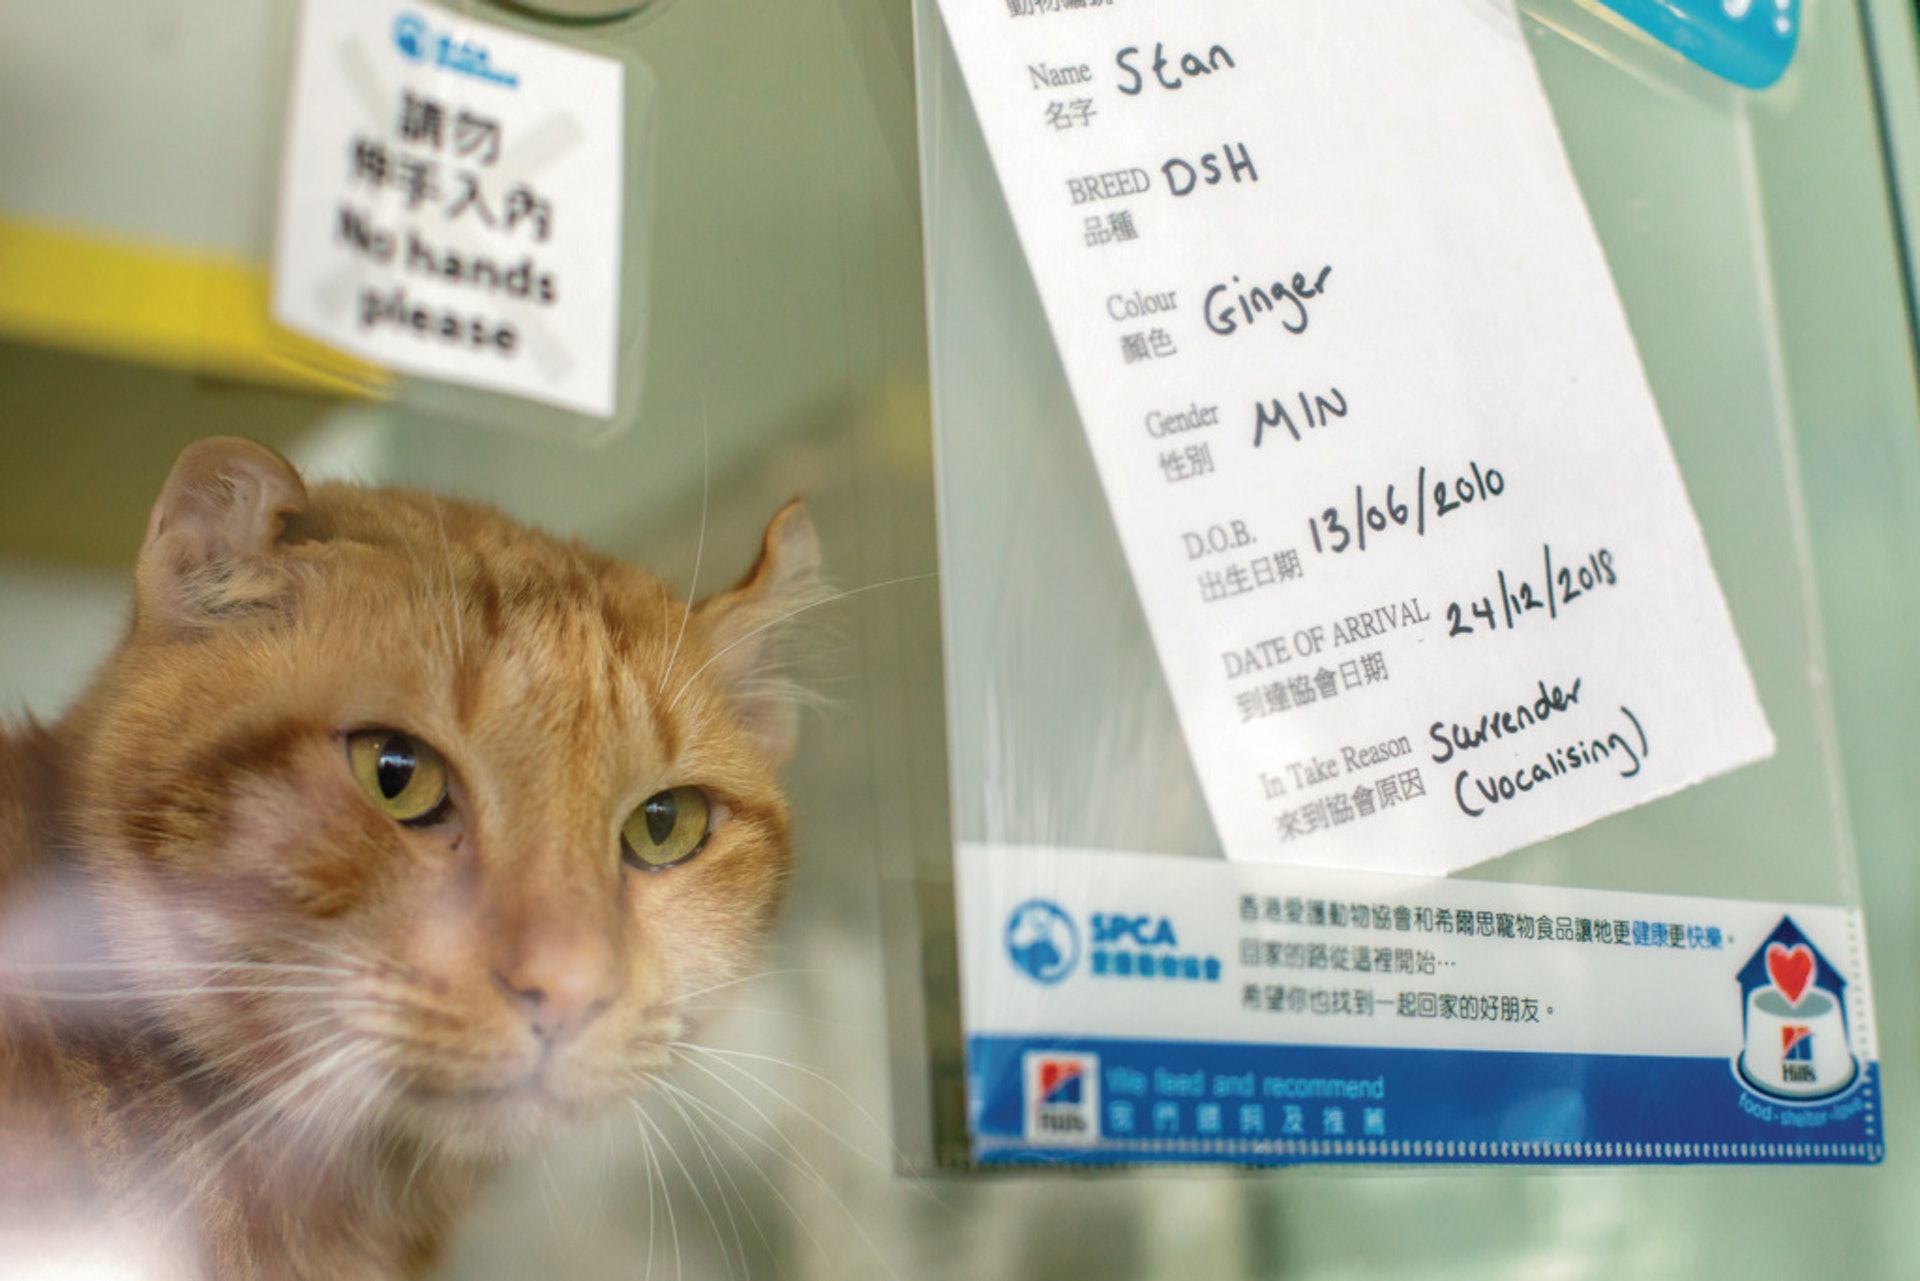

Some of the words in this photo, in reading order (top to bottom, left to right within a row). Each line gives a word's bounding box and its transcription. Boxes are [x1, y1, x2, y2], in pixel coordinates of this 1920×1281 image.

[1028, 60, 1093, 90] Name
[1115, 41, 1236, 96] Stan
[402, 90, 503, 165] 請勿
[1045, 97, 1098, 132] 名字
[1067, 168, 1151, 205] BREED
[335, 207, 395, 264] No
[406, 232, 557, 303] hands
[1084, 210, 1139, 247] 品種
[360, 288, 518, 352] please
[1106, 288, 1178, 322] Colour
[1204, 265, 1332, 336] Ginger
[1145, 403, 1220, 439] Gender
[1158, 442, 1215, 484] 性別
[1309, 461, 1505, 553] 13/06/2010
[1182, 519, 1257, 561] D.O.B.
[1198, 548, 1304, 603] 出生日期
[1446, 543, 1618, 637] 24/12/2018
[1222, 636, 1292, 680] DATE
[1293, 626, 1325, 657] OF
[1332, 597, 1430, 647] ARRIVAL
[1235, 651, 1388, 723] 到達協會日期
[1429, 677, 1582, 764] Surrender
[1258, 772, 1286, 799] In
[1286, 757, 1339, 789] Take
[1340, 736, 1412, 772] Reason
[1273, 767, 1427, 843] 來到協會原因
[1091, 913, 1177, 946] SPCA
[1212, 1071, 1254, 1097] and
[1263, 1075, 1384, 1099] recommend
